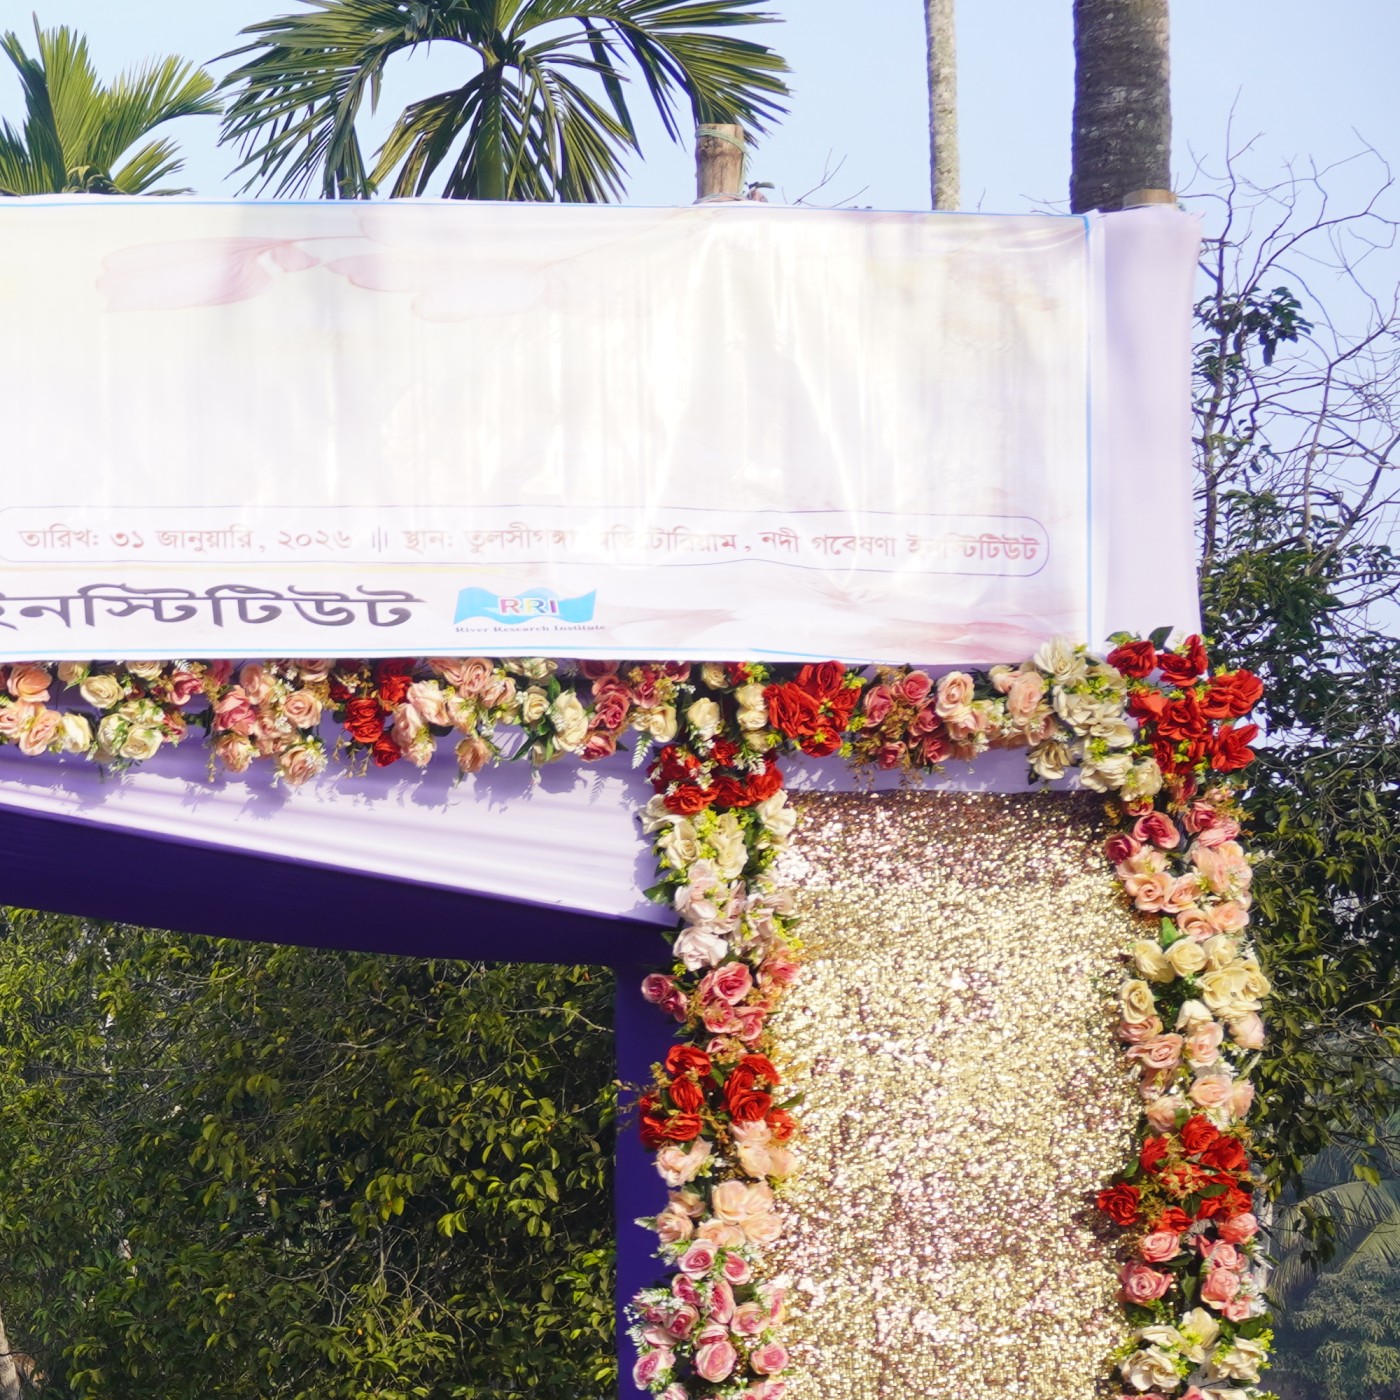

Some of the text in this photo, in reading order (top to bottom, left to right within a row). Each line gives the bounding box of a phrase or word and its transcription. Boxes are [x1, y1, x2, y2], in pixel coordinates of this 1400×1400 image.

[17, 524, 99, 550] তারিখ:
[111, 531, 146, 550] ৩১
[278, 530, 353, 550] ২০২৬
[760, 527, 800, 556] নদী
[811, 533, 897, 558] গবেষণা
[499, 597, 559, 614] RRI
